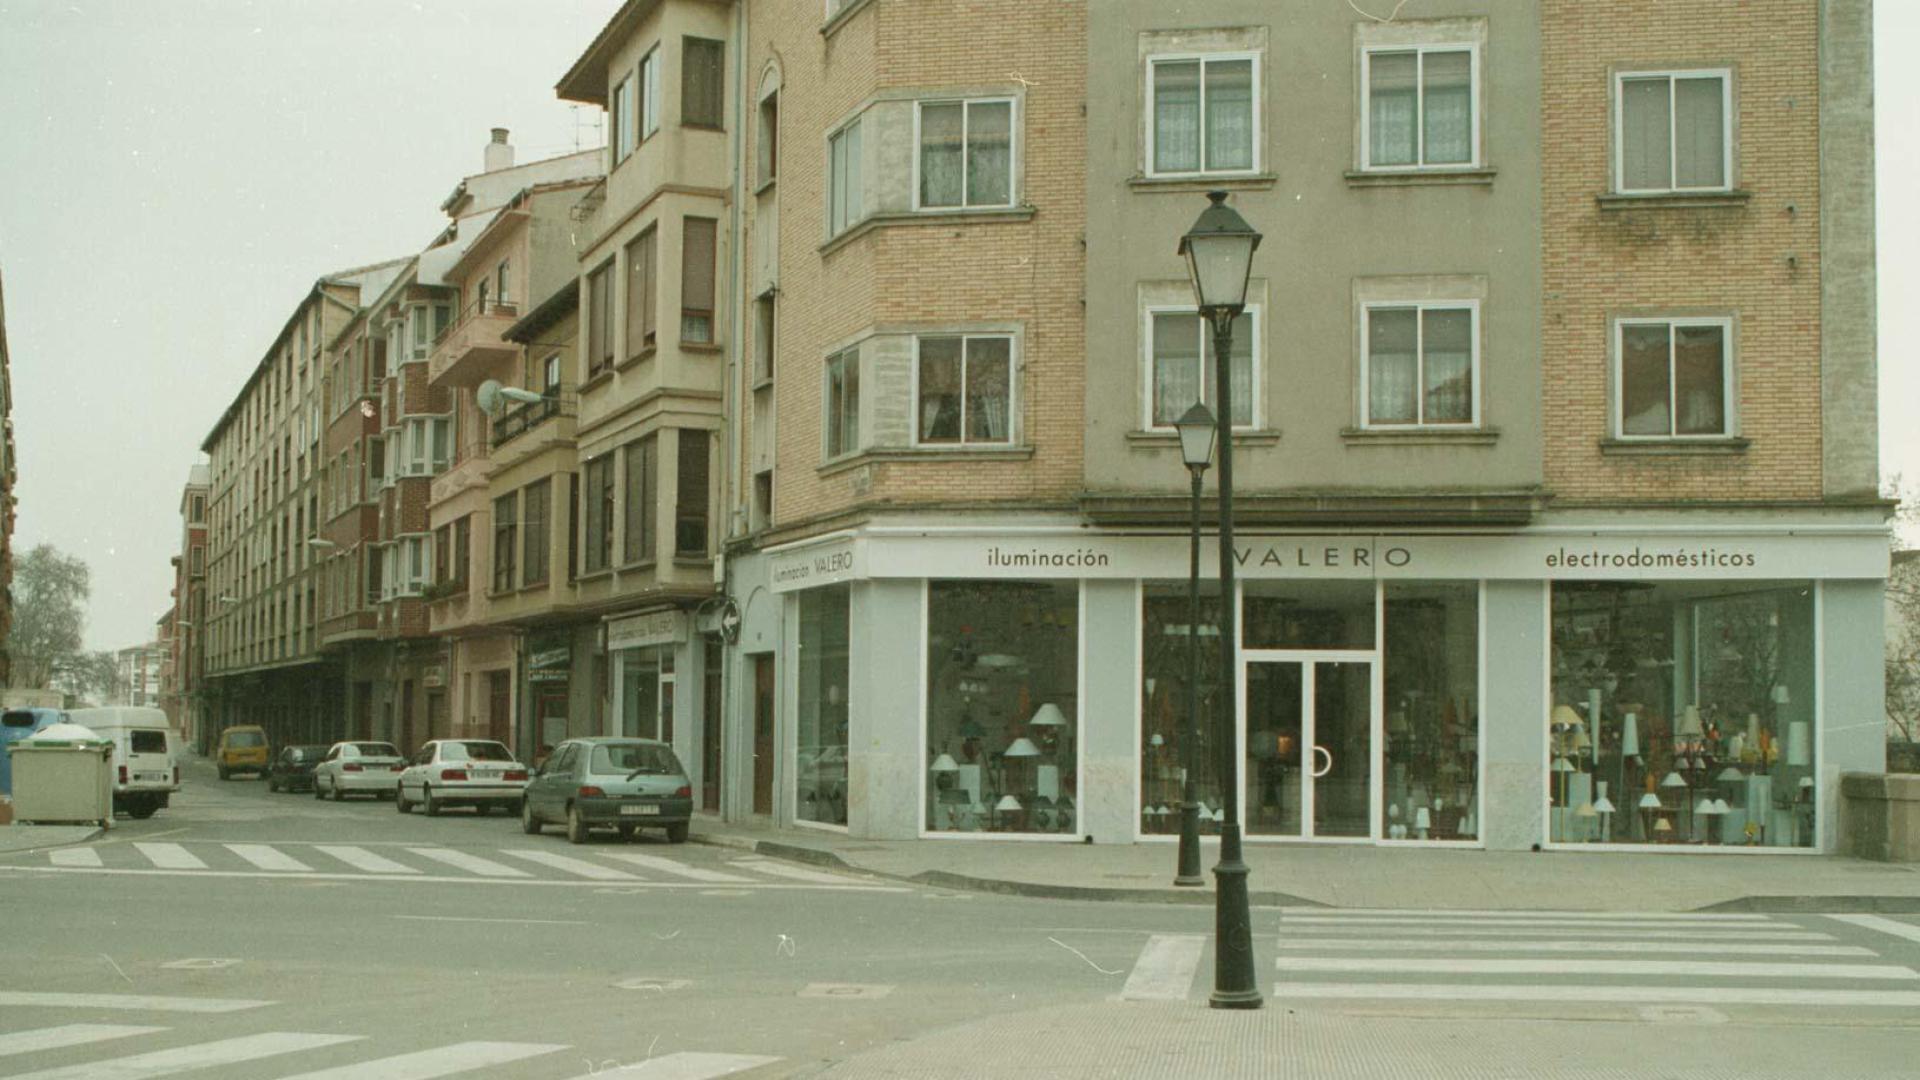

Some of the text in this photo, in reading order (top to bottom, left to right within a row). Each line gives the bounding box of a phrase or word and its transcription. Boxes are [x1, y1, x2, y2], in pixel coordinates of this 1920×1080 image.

[814, 550, 853, 574] VALERO
[988, 547, 1755, 567] iluminación VALERO electrodomésticos
